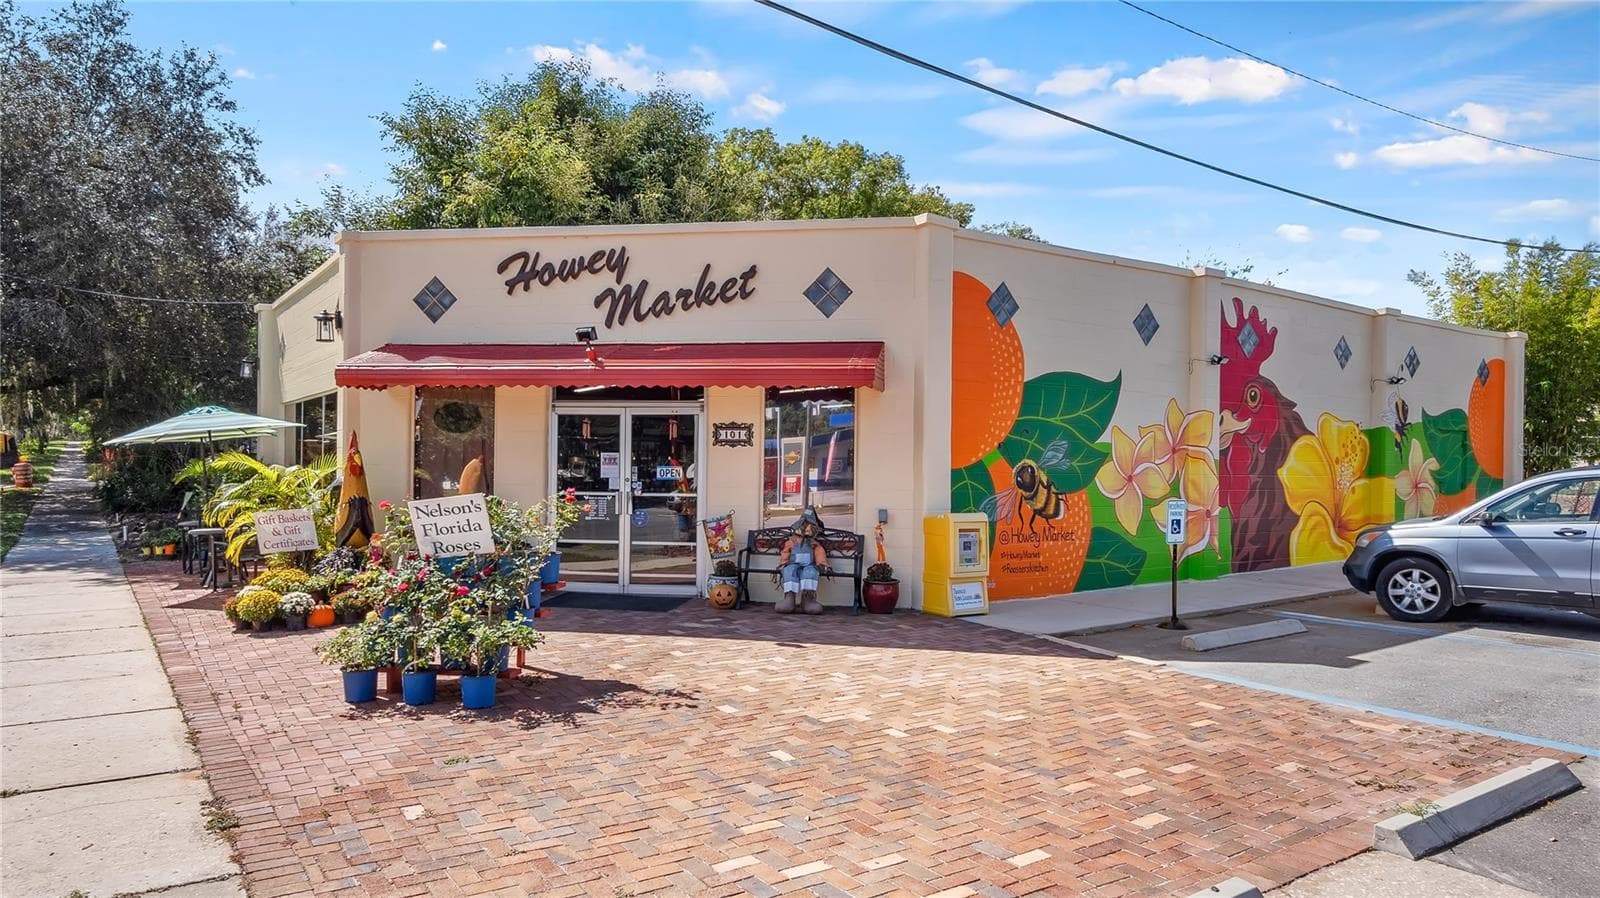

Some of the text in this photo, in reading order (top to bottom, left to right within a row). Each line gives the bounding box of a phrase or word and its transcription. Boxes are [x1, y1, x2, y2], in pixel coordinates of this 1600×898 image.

[497, 246, 630, 296] Howey
[594, 263, 758, 329] Market
[724, 431, 742, 439] 101
[659, 468, 681, 477] OPEN
[414, 499, 482, 519] Nelson's
[257, 513, 311, 525] Gift Baskets
[271, 525, 301, 536] & Gift
[421, 518, 483, 537] Florida
[1042, 526, 1075, 542] Market
[263, 538, 315, 549] Certificates
[432, 541, 482, 554] Roses
